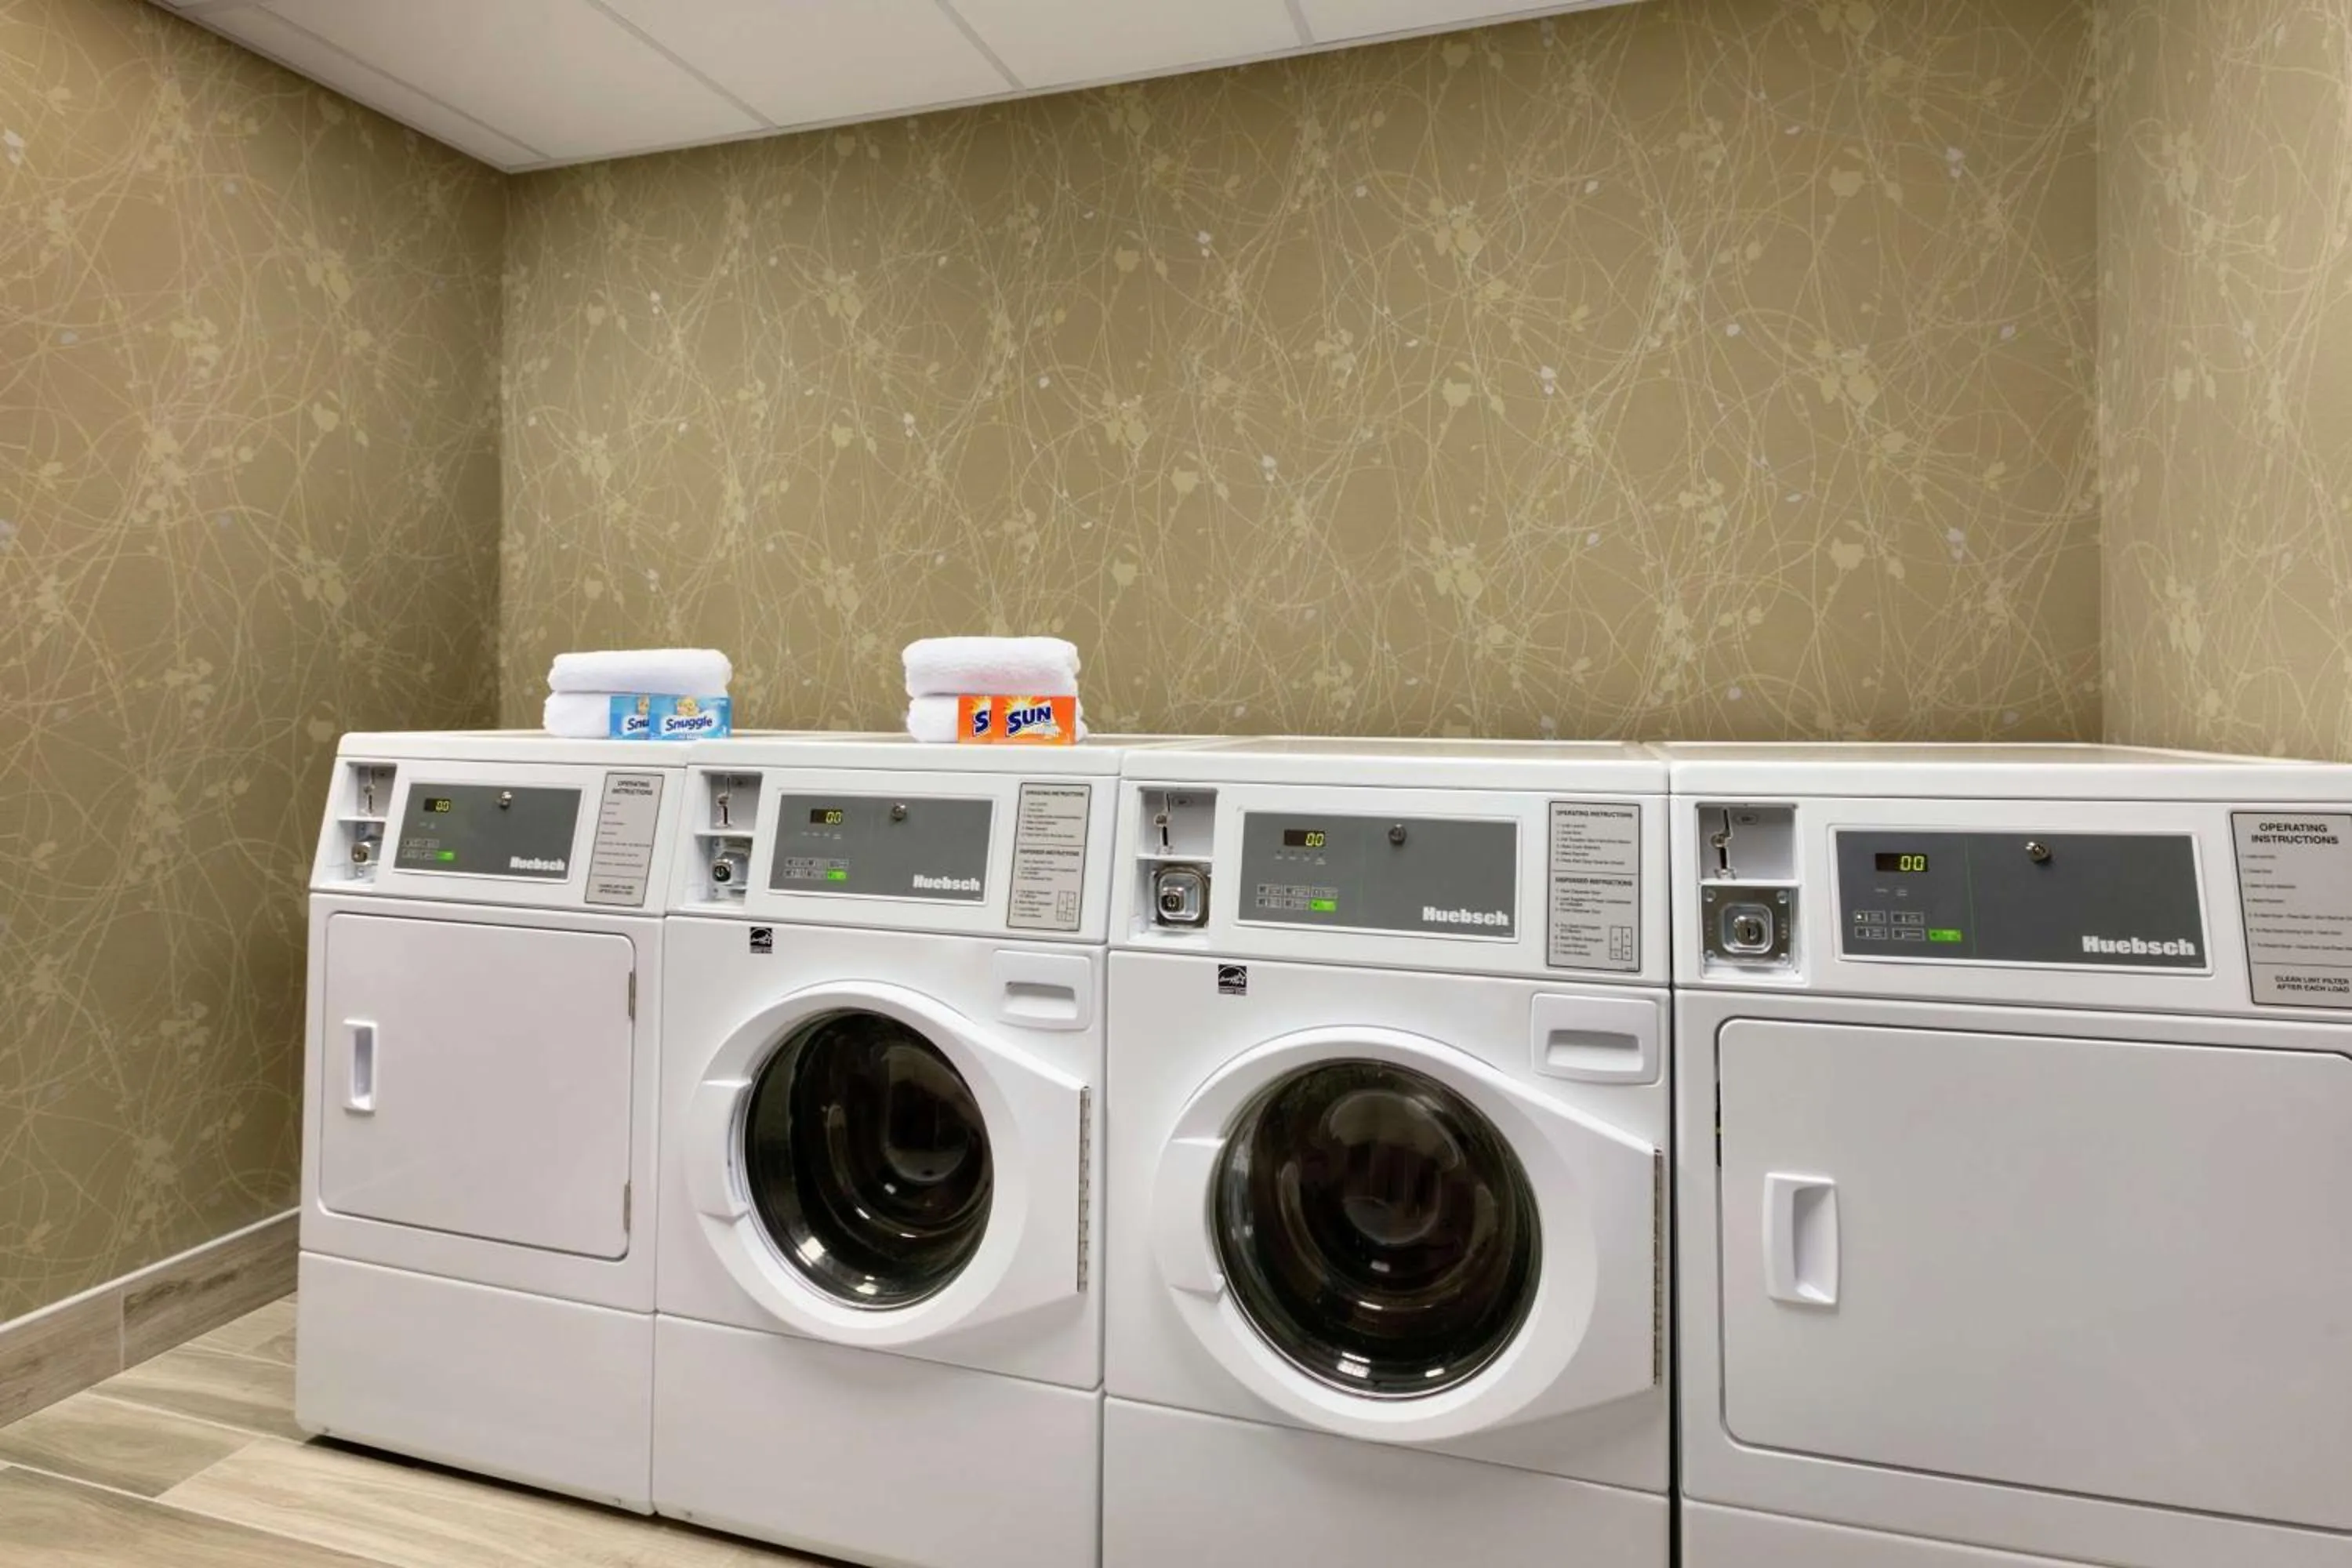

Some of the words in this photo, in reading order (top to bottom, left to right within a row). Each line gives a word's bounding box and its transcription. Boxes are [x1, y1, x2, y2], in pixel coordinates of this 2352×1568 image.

[665, 716, 713, 731] Snuggle
[975, 710, 991, 734] S
[1007, 706, 1051, 735] SUN
[826, 811, 842, 823] 00
[2259, 822, 2328, 833] OPERATING
[1305, 832, 1325, 847] 00
[2251, 834, 2339, 844] INSTRUCTIONS
[510, 856, 565, 871] Huebsch
[1900, 855, 1925, 872] 00
[913, 874, 981, 891] Huebsch
[1422, 906, 1509, 927] Huebsch
[2082, 935, 2196, 956] Huebsch
